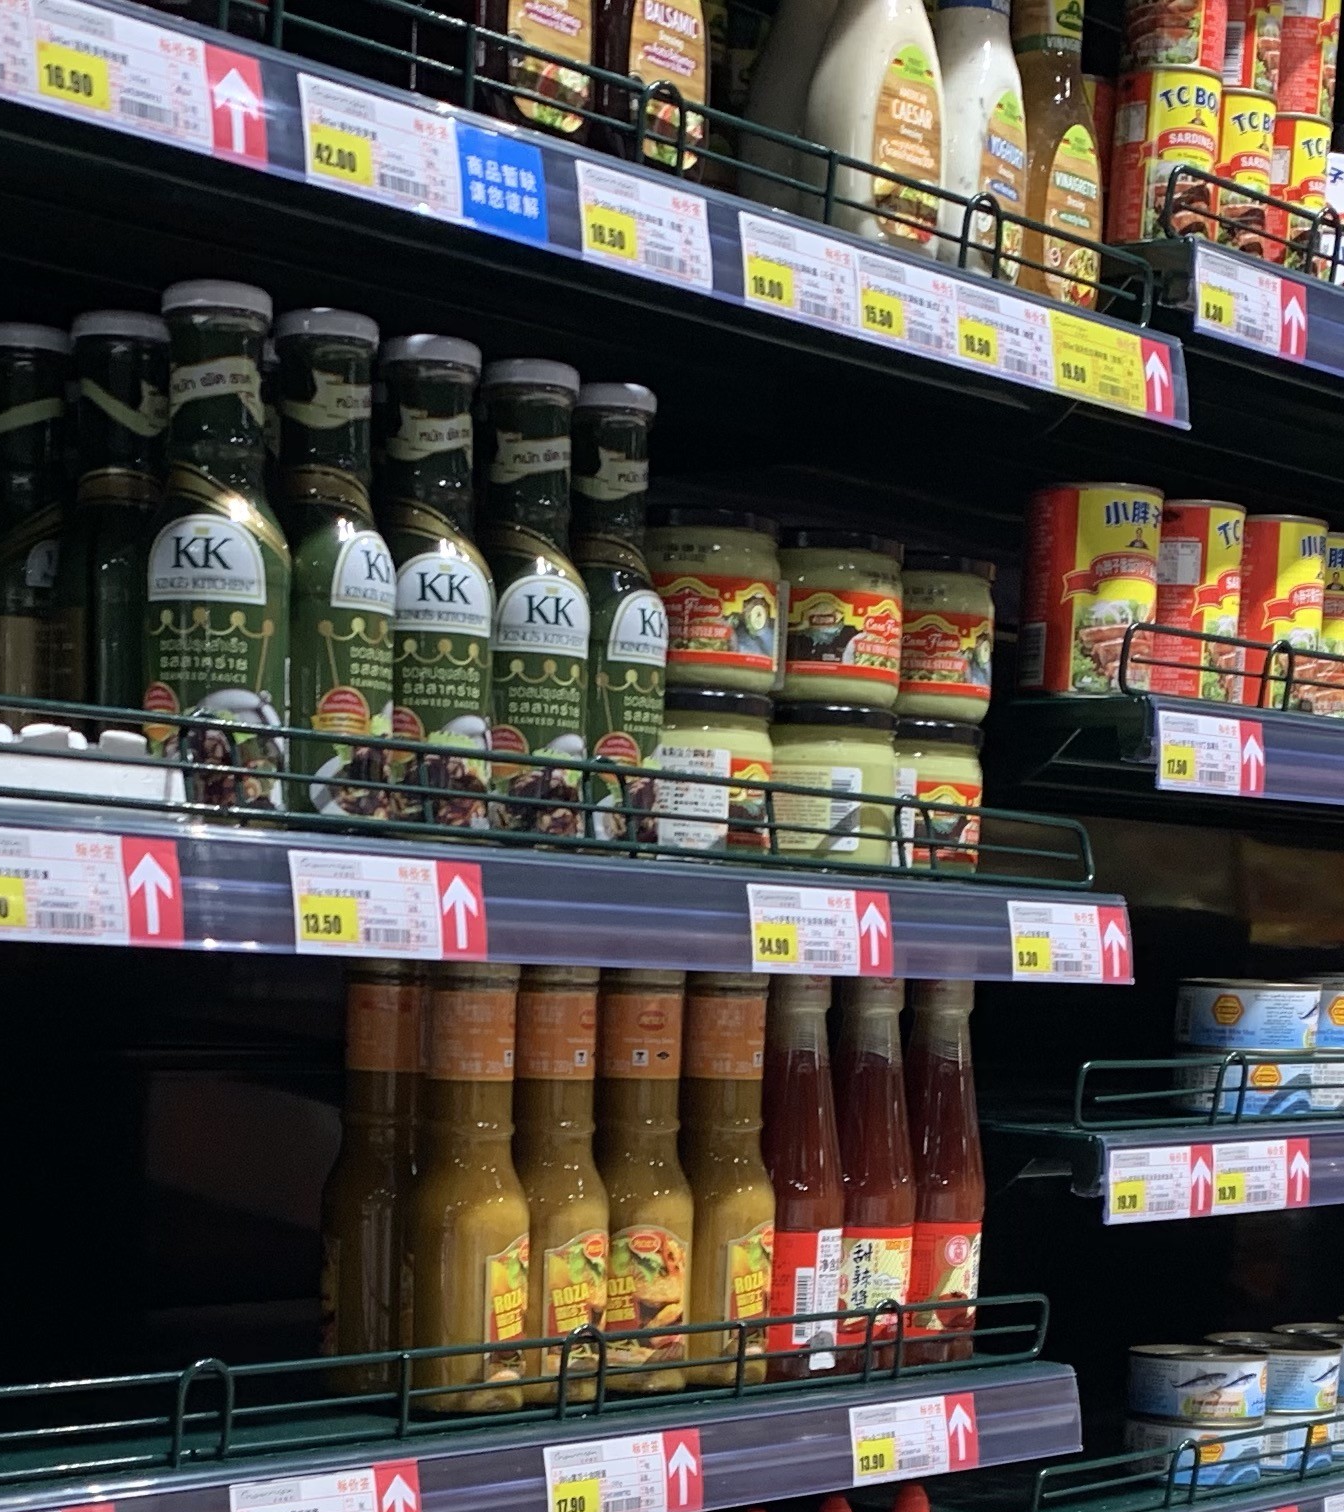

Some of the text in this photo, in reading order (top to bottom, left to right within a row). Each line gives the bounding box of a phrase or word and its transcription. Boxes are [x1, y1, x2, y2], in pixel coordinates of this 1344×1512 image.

[43, 64, 93, 97] 16.90
[1160, 87, 1191, 109] TC
[891, 101, 933, 131] CAESAR
[1233, 111, 1256, 134] TC
[314, 142, 358, 173] 42.00
[467, 154, 539, 197] 商品暂缺
[469, 182, 540, 219] 请您谅解
[172, 535, 234, 571] KK
[418, 572, 472, 606] KK
[526, 594, 575, 628] KK
[303, 913, 344, 936] 13.50
